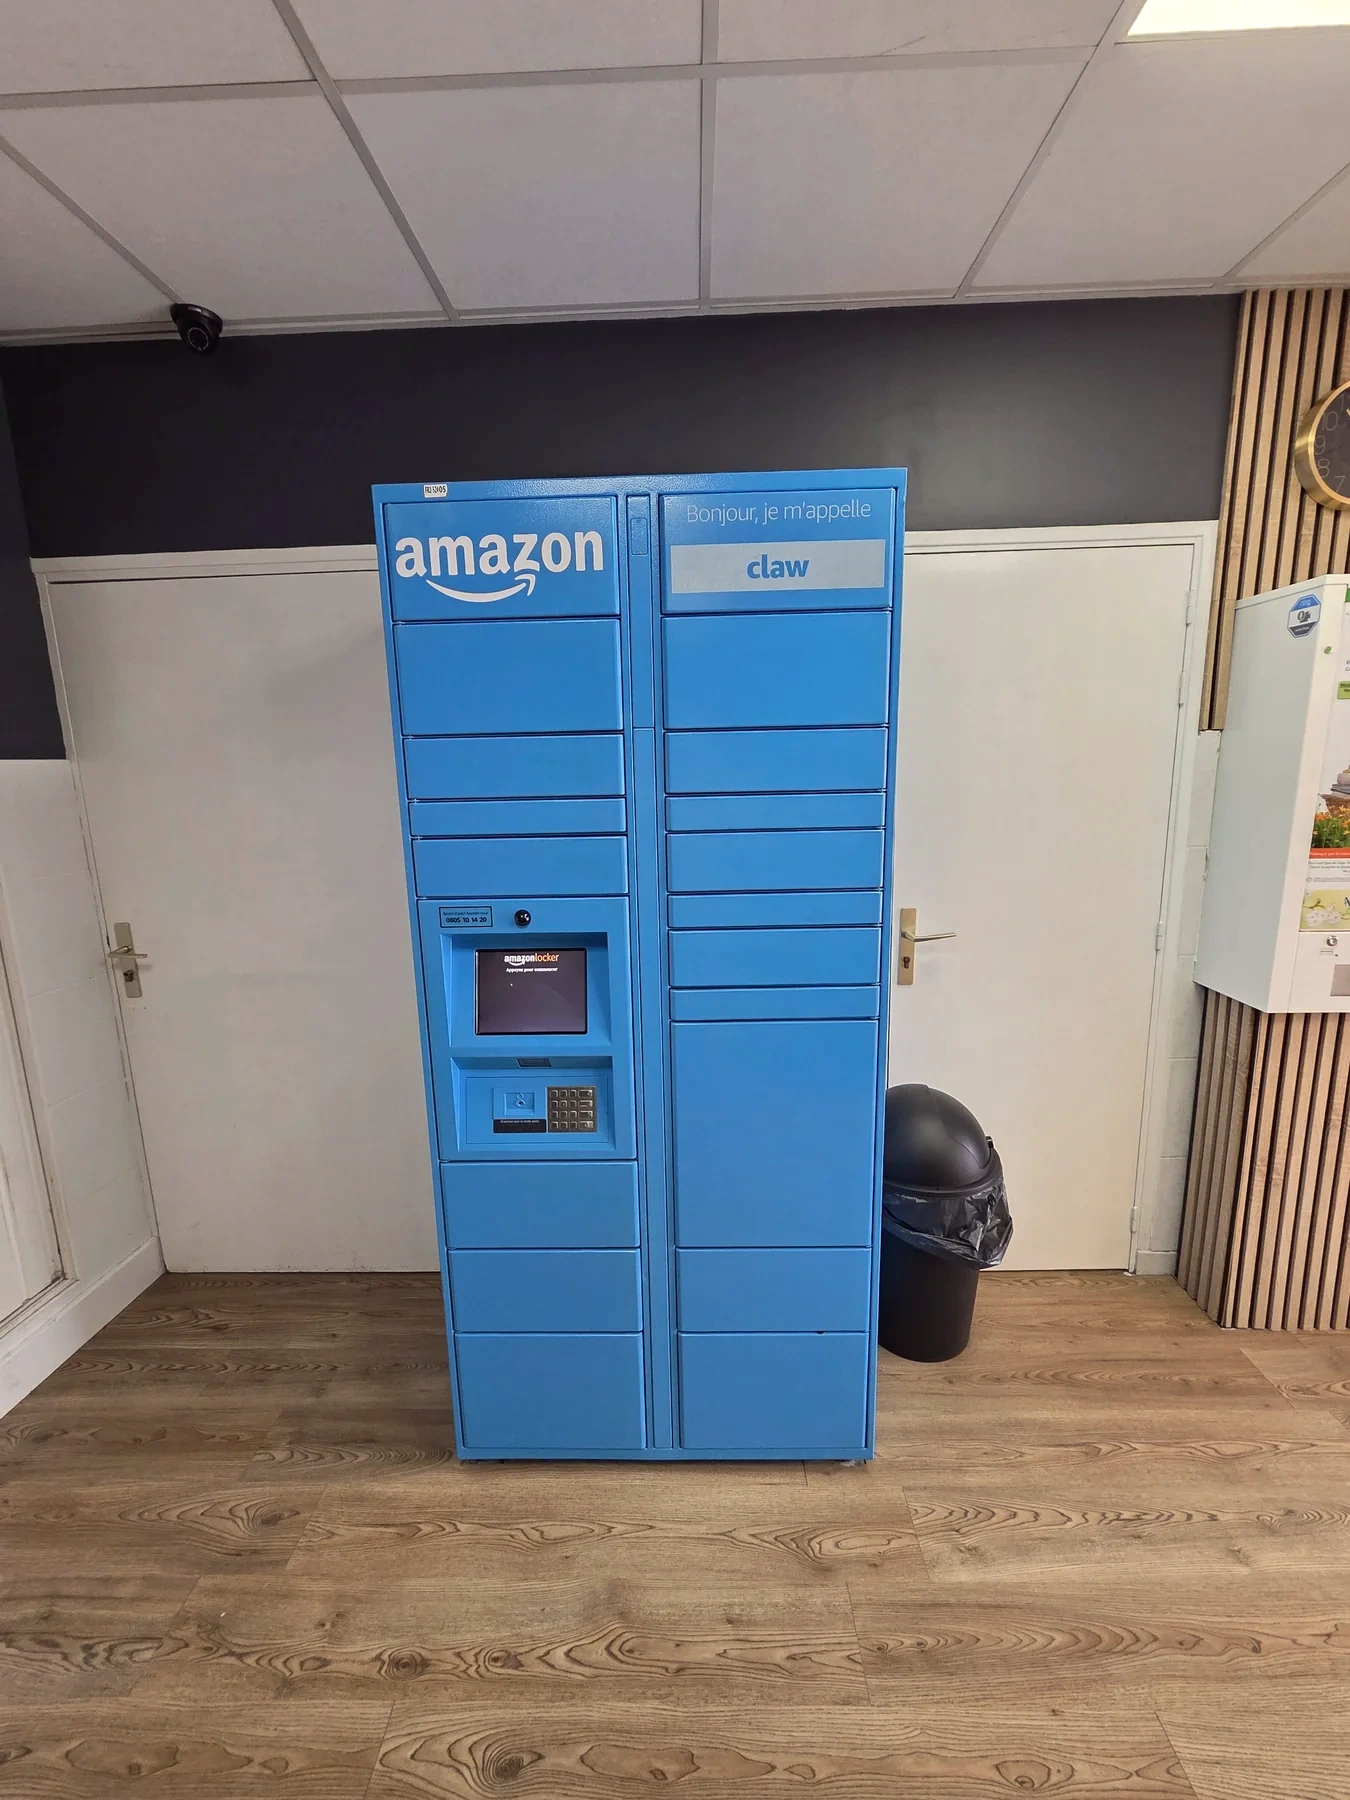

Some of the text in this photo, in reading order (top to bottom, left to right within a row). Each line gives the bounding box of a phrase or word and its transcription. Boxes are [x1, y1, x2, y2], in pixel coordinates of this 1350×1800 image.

[1322, 411, 1339, 431] 10
[1315, 436, 1326, 455] 9
[1318, 459, 1330, 478] 8
[1334, 476, 1345, 493] 7
[687, 499, 871, 526] Bonjour, je m'appelle
[395, 530, 604, 579] amazon
[746, 554, 809, 580] claw
